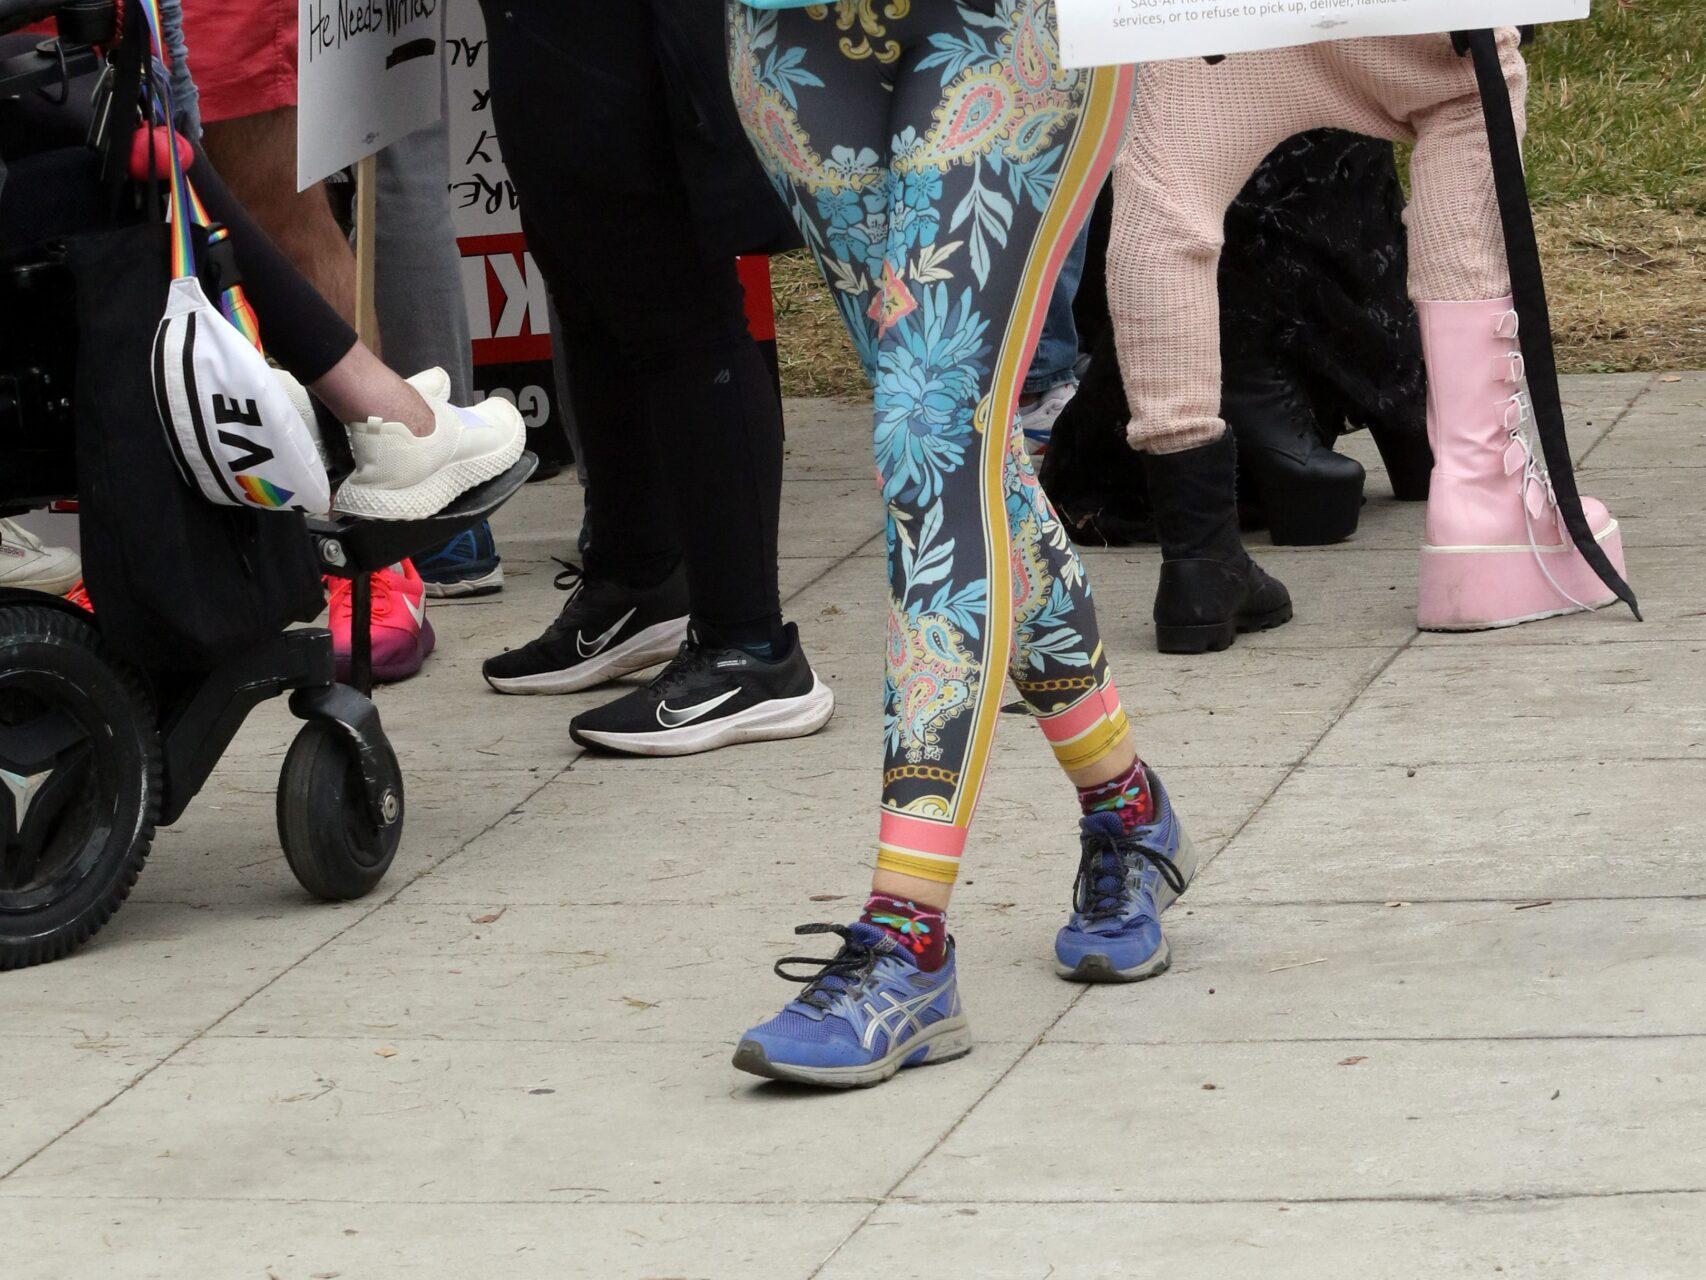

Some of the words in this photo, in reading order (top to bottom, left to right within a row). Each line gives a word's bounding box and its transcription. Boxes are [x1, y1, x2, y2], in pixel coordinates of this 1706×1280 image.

[1113, 11, 1166, 28] services,
[1169, 11, 1182, 22] or
[1185, 9, 1198, 21] to
[1202, 5, 1239, 19] refuse
[1243, 3, 1256, 16] to
[1259, 1, 1284, 18] pick
[1288, 1, 1307, 14] up,
